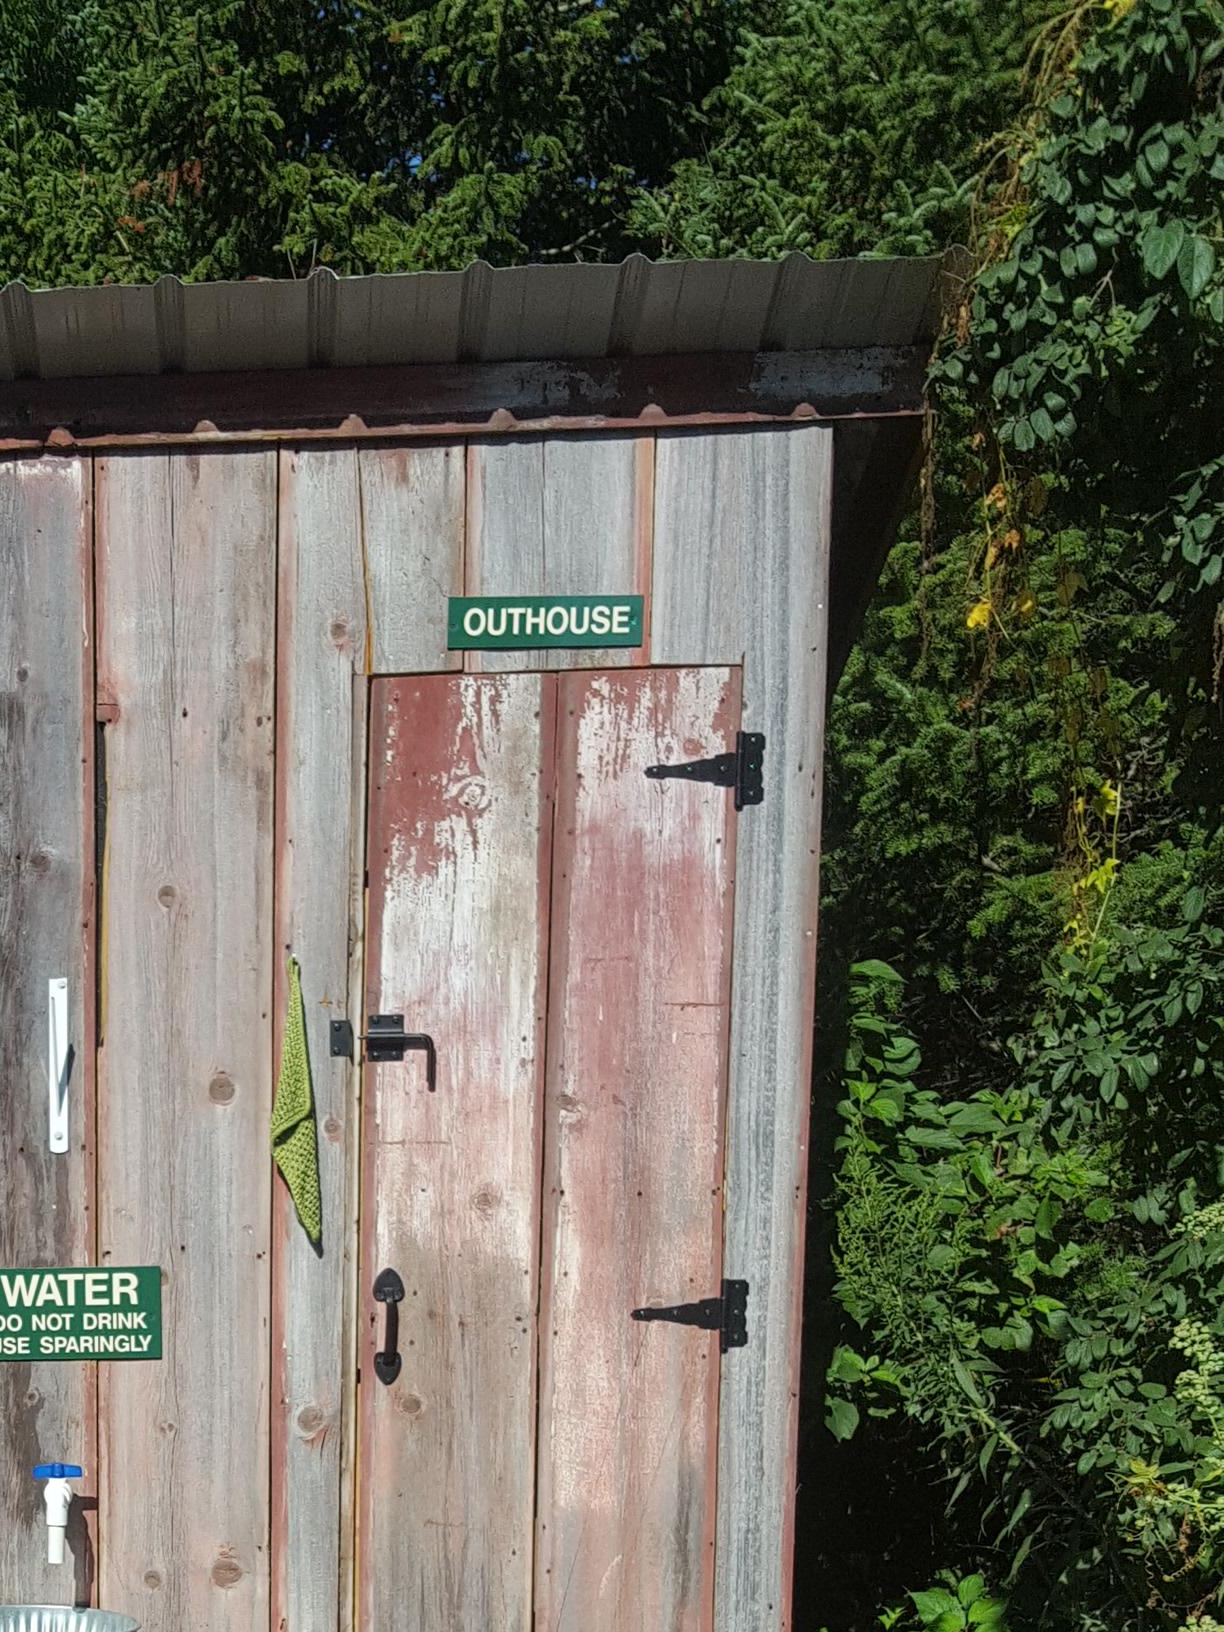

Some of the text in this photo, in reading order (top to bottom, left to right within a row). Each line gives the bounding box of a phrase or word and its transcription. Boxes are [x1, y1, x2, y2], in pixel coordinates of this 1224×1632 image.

[463, 605, 631, 637] OUTHOUSE
[0, 1272, 139, 1308] WATER
[31, 1313, 74, 1331] NOT
[83, 1312, 147, 1330] DRINK
[39, 1334, 152, 1354] SPARINGLY
